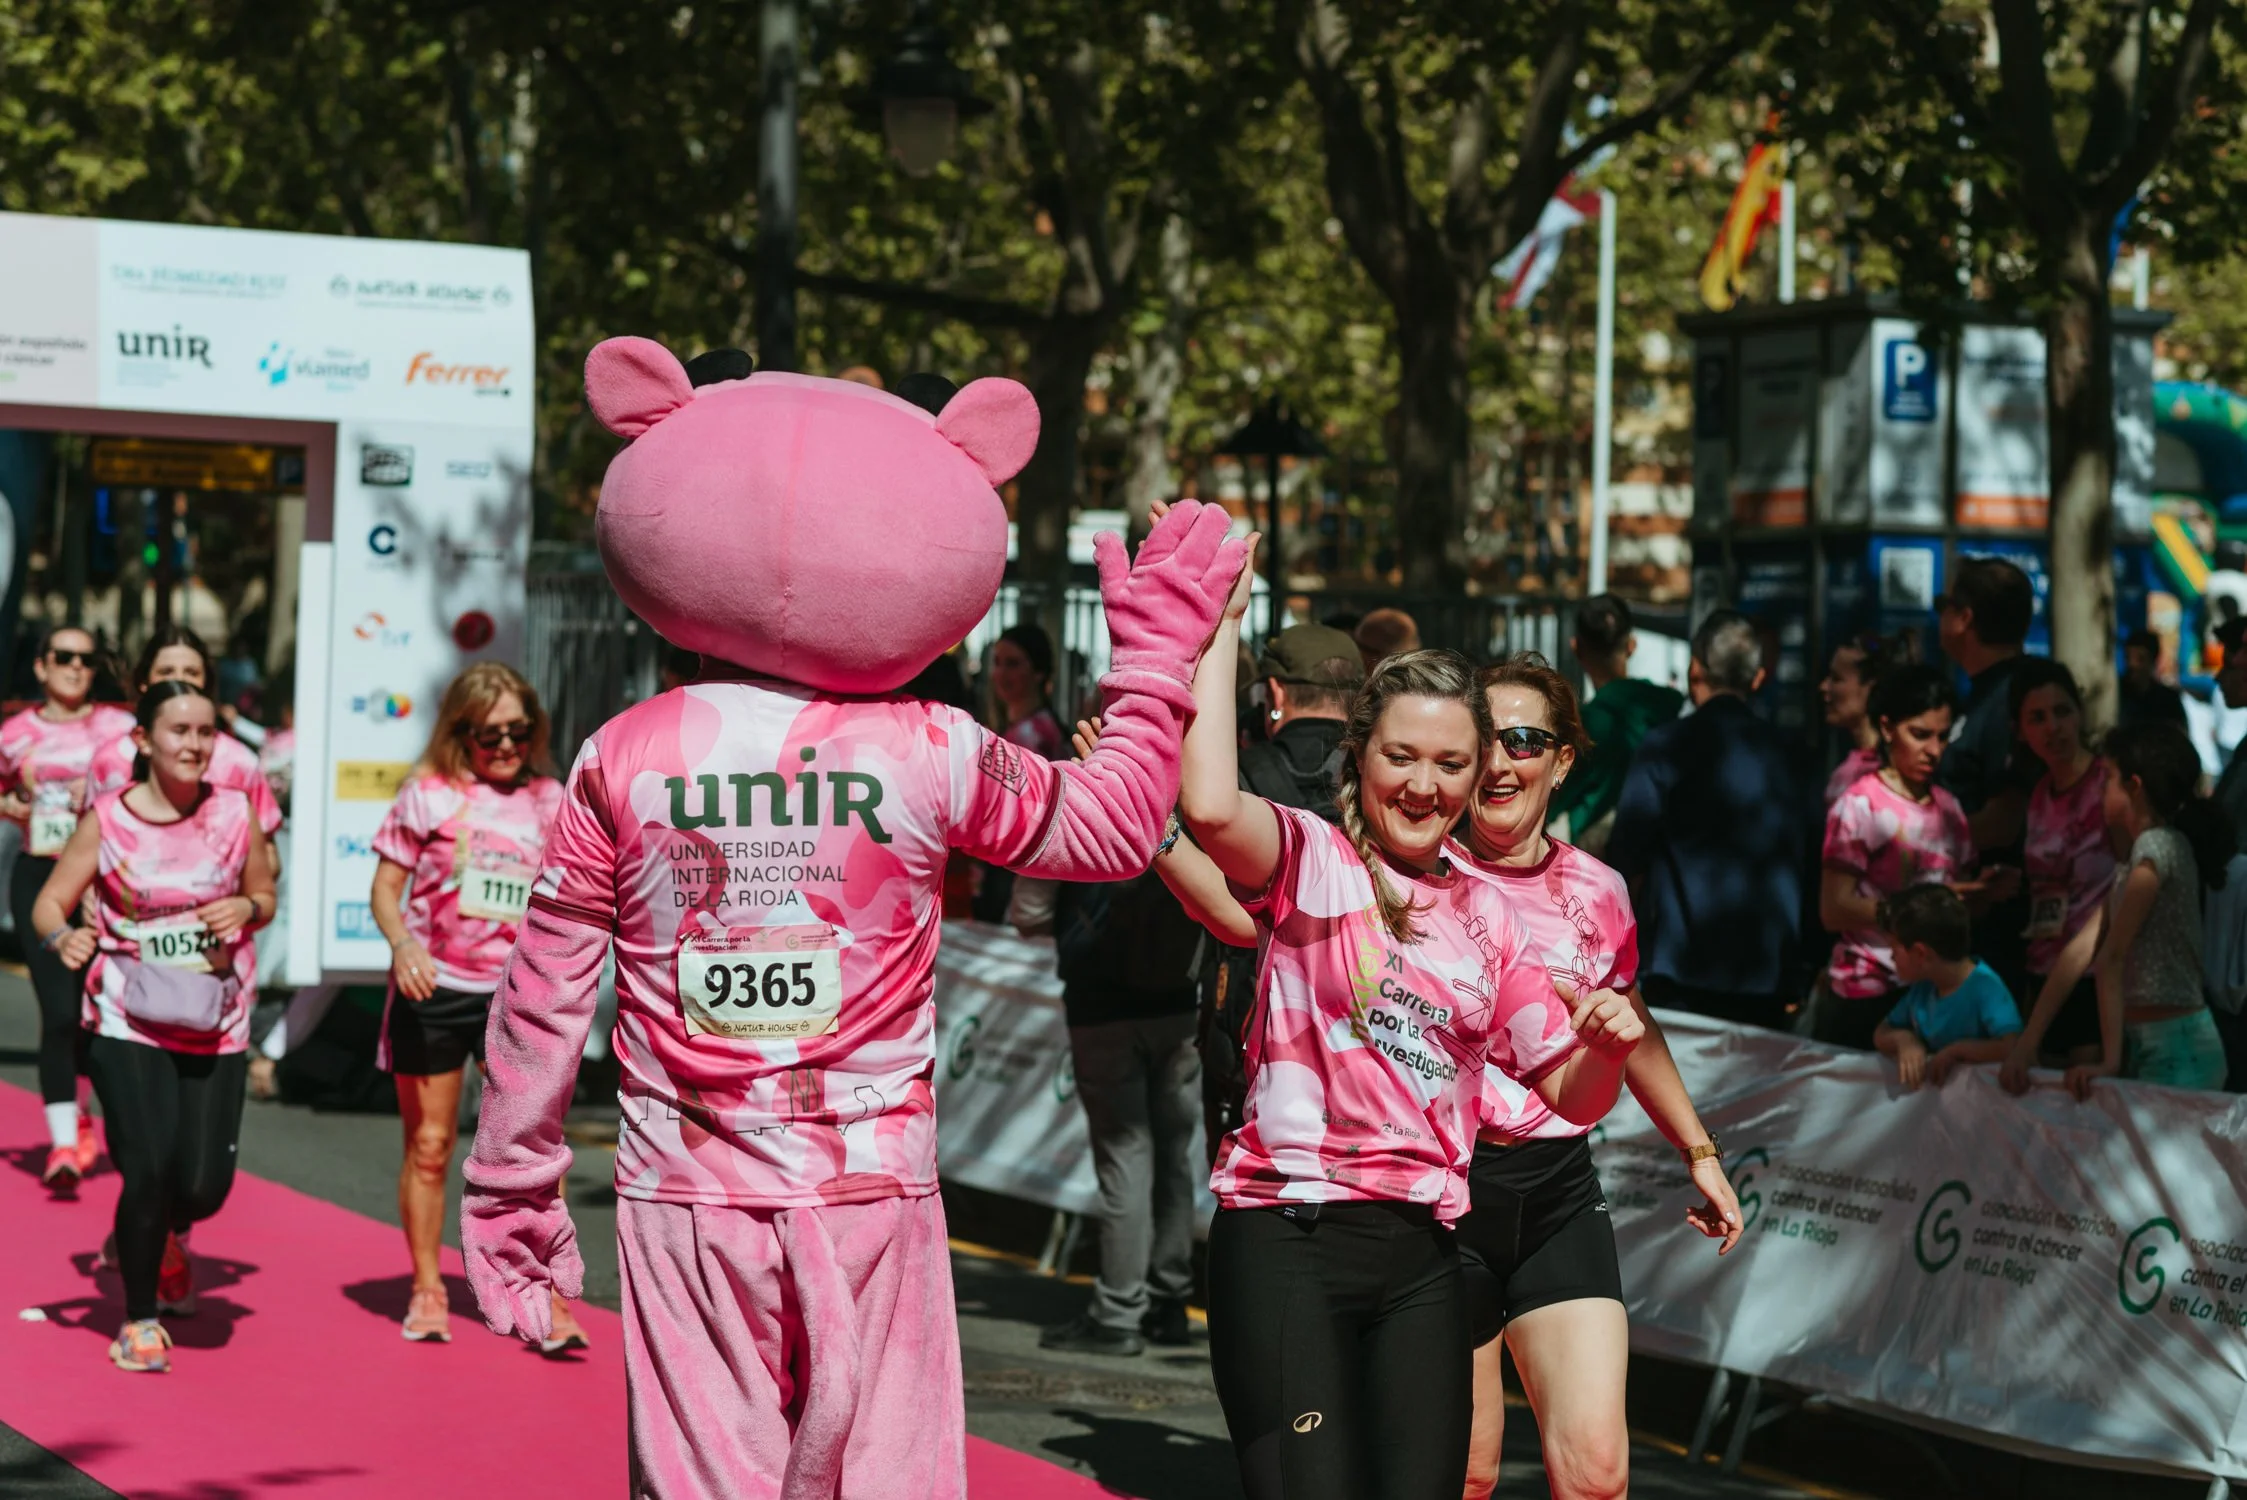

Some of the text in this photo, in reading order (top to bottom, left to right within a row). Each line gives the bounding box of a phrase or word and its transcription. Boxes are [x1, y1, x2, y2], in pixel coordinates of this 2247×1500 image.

[1895, 344, 1926, 388] P
[669, 841, 816, 861] UNIVERSIDAD
[672, 865, 848, 885] INTERNACIONAL
[674, 889, 799, 908] DE LA RIOJA
[1384, 949, 1403, 974] XI
[705, 962, 816, 1009] 9365
[1379, 977, 1448, 1025] Carrera
[733, 1023, 798, 1032] NATUR HOUSE
[1369, 1008, 1421, 1042] por la
[1333, 1115, 1369, 1130] Logroño
[1393, 1125, 1404, 1136] La
[1404, 1127, 1421, 1140] Rioja
[1771, 1189, 1817, 1212] contra
[1818, 1196, 1833, 1214] el
[1781, 1215, 1799, 1237] La
[1802, 1219, 1839, 1248] Rioja
[1973, 1227, 2016, 1250] contra
[2019, 1233, 2034, 1252] el
[1963, 1255, 2036, 1288] en La Rioja
[2181, 1268, 2247, 1294] contra el
[2169, 1295, 2188, 1314] en
[2189, 1295, 2212, 1319] La
